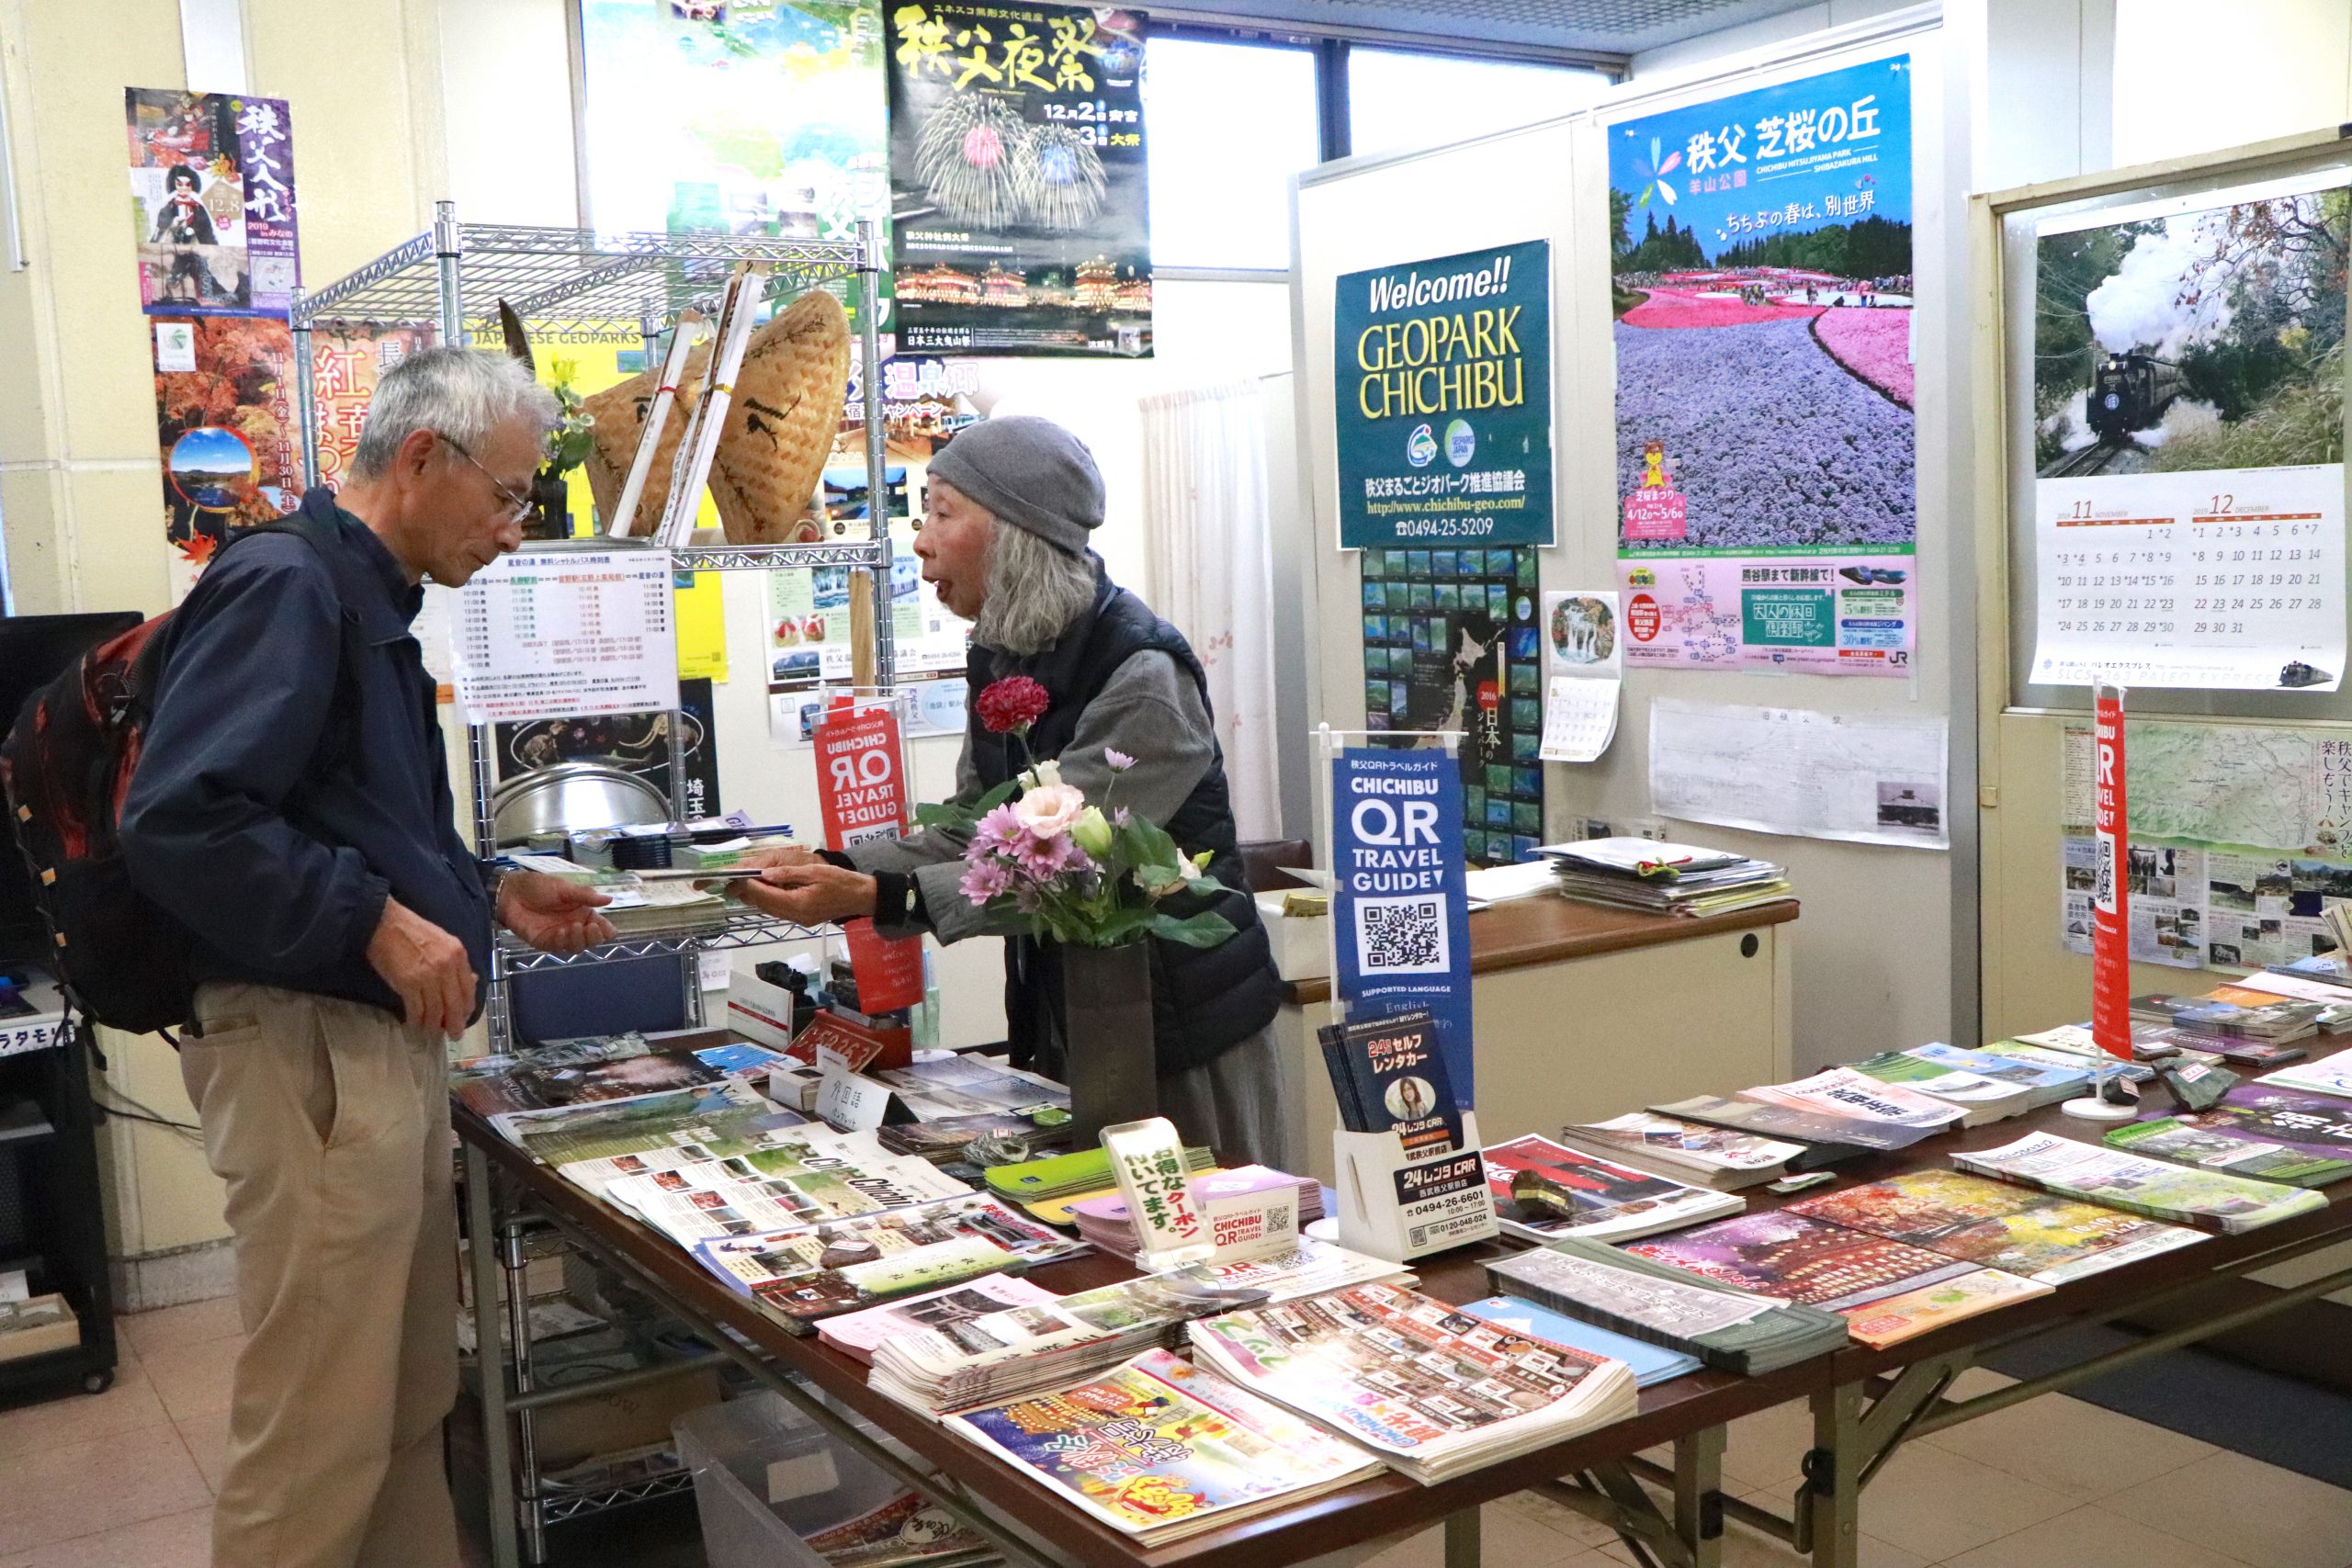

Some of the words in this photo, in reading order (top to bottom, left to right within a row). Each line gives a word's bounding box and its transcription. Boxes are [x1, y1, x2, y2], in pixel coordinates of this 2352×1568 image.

[893, 5, 1106, 94] 秩父夜祭
[1686, 123, 1747, 175] 秩父
[1755, 94, 1881, 161] 芝桜の丘
[1756, 161, 1788, 175] CHICHIBU
[1788, 152, 1832, 170] HITSUJIYAMA
[1832, 148, 1852, 161] PARK
[1813, 159, 1861, 173] SHIBAZAKURA
[1861, 153, 1878, 164] HILL
[1689, 169, 1747, 196] 羊山公園
[1725, 189, 1876, 235] ちちぶの春は、別世界
[247, 221, 269, 231] 2019
[1369, 255, 1511, 313] Welcome!!
[559, 332, 640, 345] GEOPARKS
[1357, 306, 1521, 372] GEOPARK
[1359, 357, 1524, 420] CHICHIBU
[1365, 469, 1525, 499] 秩父まるごとジオパーク推進協議会
[1366, 495, 1526, 516] http://www.chichibu-geo.com/
[1635, 490, 1675, 502] 芝桜まつり
[2209, 494, 2233, 514] 12
[2072, 500, 2093, 519] 11
[1407, 517, 1494, 536] 0494-25-5209
[2146, 529, 2153, 539] 1
[2165, 528, 2172, 538] 2
[2199, 527, 2205, 537] 1
[2216, 526, 2223, 537] 2
[2234, 526, 2242, 536] 3
[2253, 526, 2260, 536] 4
[2272, 525, 2279, 536] 5
[2291, 525, 2299, 535] 6
[2311, 525, 2318, 535] 7
[2062, 554, 2069, 564] 3
[2078, 554, 2086, 563] 4
[2096, 554, 2102, 563] 5
[2112, 553, 2119, 563] 6
[2130, 552, 2136, 562] 7
[2146, 552, 2154, 562] 8
[2165, 552, 2172, 562] 9
[2198, 551, 2205, 561] 8
[2216, 551, 2223, 560] 9
[2232, 550, 2245, 560] 10
[2251, 550, 2263, 560] 11
[2269, 550, 2282, 560] 12
[2289, 549, 2301, 559] 13
[2308, 549, 2321, 559] 14
[2061, 576, 2072, 586] 10
[2076, 576, 2087, 586] 11
[2094, 576, 2104, 586] 12
[2110, 576, 2121, 586] 13
[2127, 576, 2138, 585] 14
[2144, 576, 2156, 585] 15
[2162, 576, 2175, 585] 16
[2195, 575, 2207, 585] 15
[2213, 575, 2225, 585] 16
[2232, 575, 2245, 585] 17
[2251, 574, 2263, 584] 18
[2269, 574, 2282, 584] 19
[2288, 574, 2301, 584] 20
[2308, 574, 2320, 584] 21
[1753, 603, 1816, 621] 大人の休日
[2061, 599, 2072, 609] 17
[2077, 599, 2088, 608] 18
[2094, 599, 2105, 608] 19
[2109, 599, 2121, 608] 20
[2127, 599, 2138, 608] 21
[2144, 599, 2156, 609] 22
[2162, 598, 2174, 609] 23
[2194, 599, 2207, 609] 22
[2212, 599, 2225, 609] 23
[2231, 599, 2244, 609] 24
[2250, 599, 2263, 609] 25
[2268, 599, 2282, 609] 26
[2289, 599, 2301, 609] 27
[2308, 598, 2322, 609] 28
[2060, 621, 2072, 631] 24
[2076, 621, 2087, 631] 25
[2093, 621, 2105, 631] 26
[2109, 621, 2121, 631] 27
[2126, 621, 2139, 631] 28
[2143, 622, 2156, 632] 29
[2162, 622, 2174, 632] 30
[2194, 622, 2207, 632] 29
[2212, 623, 2225, 633] 30
[2231, 623, 2243, 633] 31
[1889, 650, 1908, 665] JR
[1480, 691, 1498, 701] 2016
[1485, 707, 1502, 761] 日本の
[1351, 760, 1438, 772] 秩父QRトラベルガイド
[1351, 777, 1439, 795] CHICHIBU
[2321, 739, 2337, 818] 楽しもう!
[1351, 798, 1441, 846] QR
[1352, 848, 1443, 868] TRAVEL
[1362, 985, 1407, 998] SUPPORTED
[1408, 984, 1452, 994] LANGUAGE
[1373, 1053, 1428, 1075] レンタカー
[1124, 1154, 1177, 1235] 付いてます。
[1152, 1146, 1200, 1240] お得なクーポン
[1419, 1179, 1468, 1199] 西武秩父駅前店
[1415, 1190, 1485, 1217] 0494-26-6601
[1214, 1214, 1262, 1233] CHICHIBU
[1237, 1224, 1262, 1235] TRAVEL
[1440, 1213, 1487, 1234] 0120-048-024
[1215, 1230, 1238, 1247] QR
